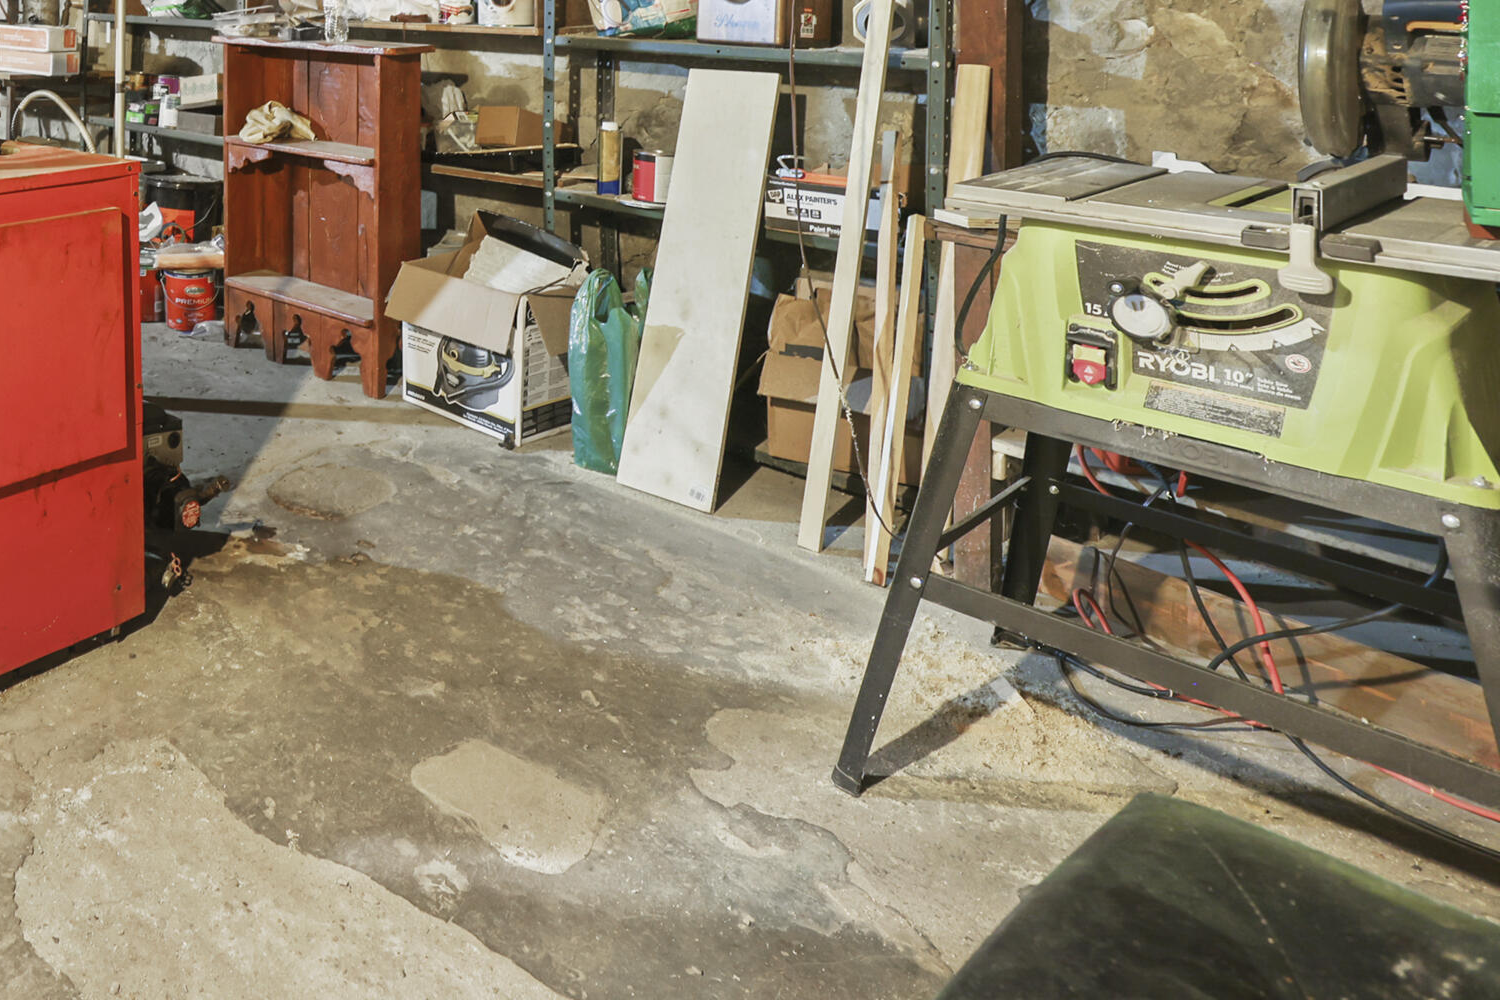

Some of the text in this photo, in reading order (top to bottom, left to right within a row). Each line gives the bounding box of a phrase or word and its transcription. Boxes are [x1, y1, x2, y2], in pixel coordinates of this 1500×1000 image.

[786, 192, 838, 206] ALX PAINTER'S
[1084, 302, 1102, 316] 15
[1137, 351, 1214, 383] RYOBI
